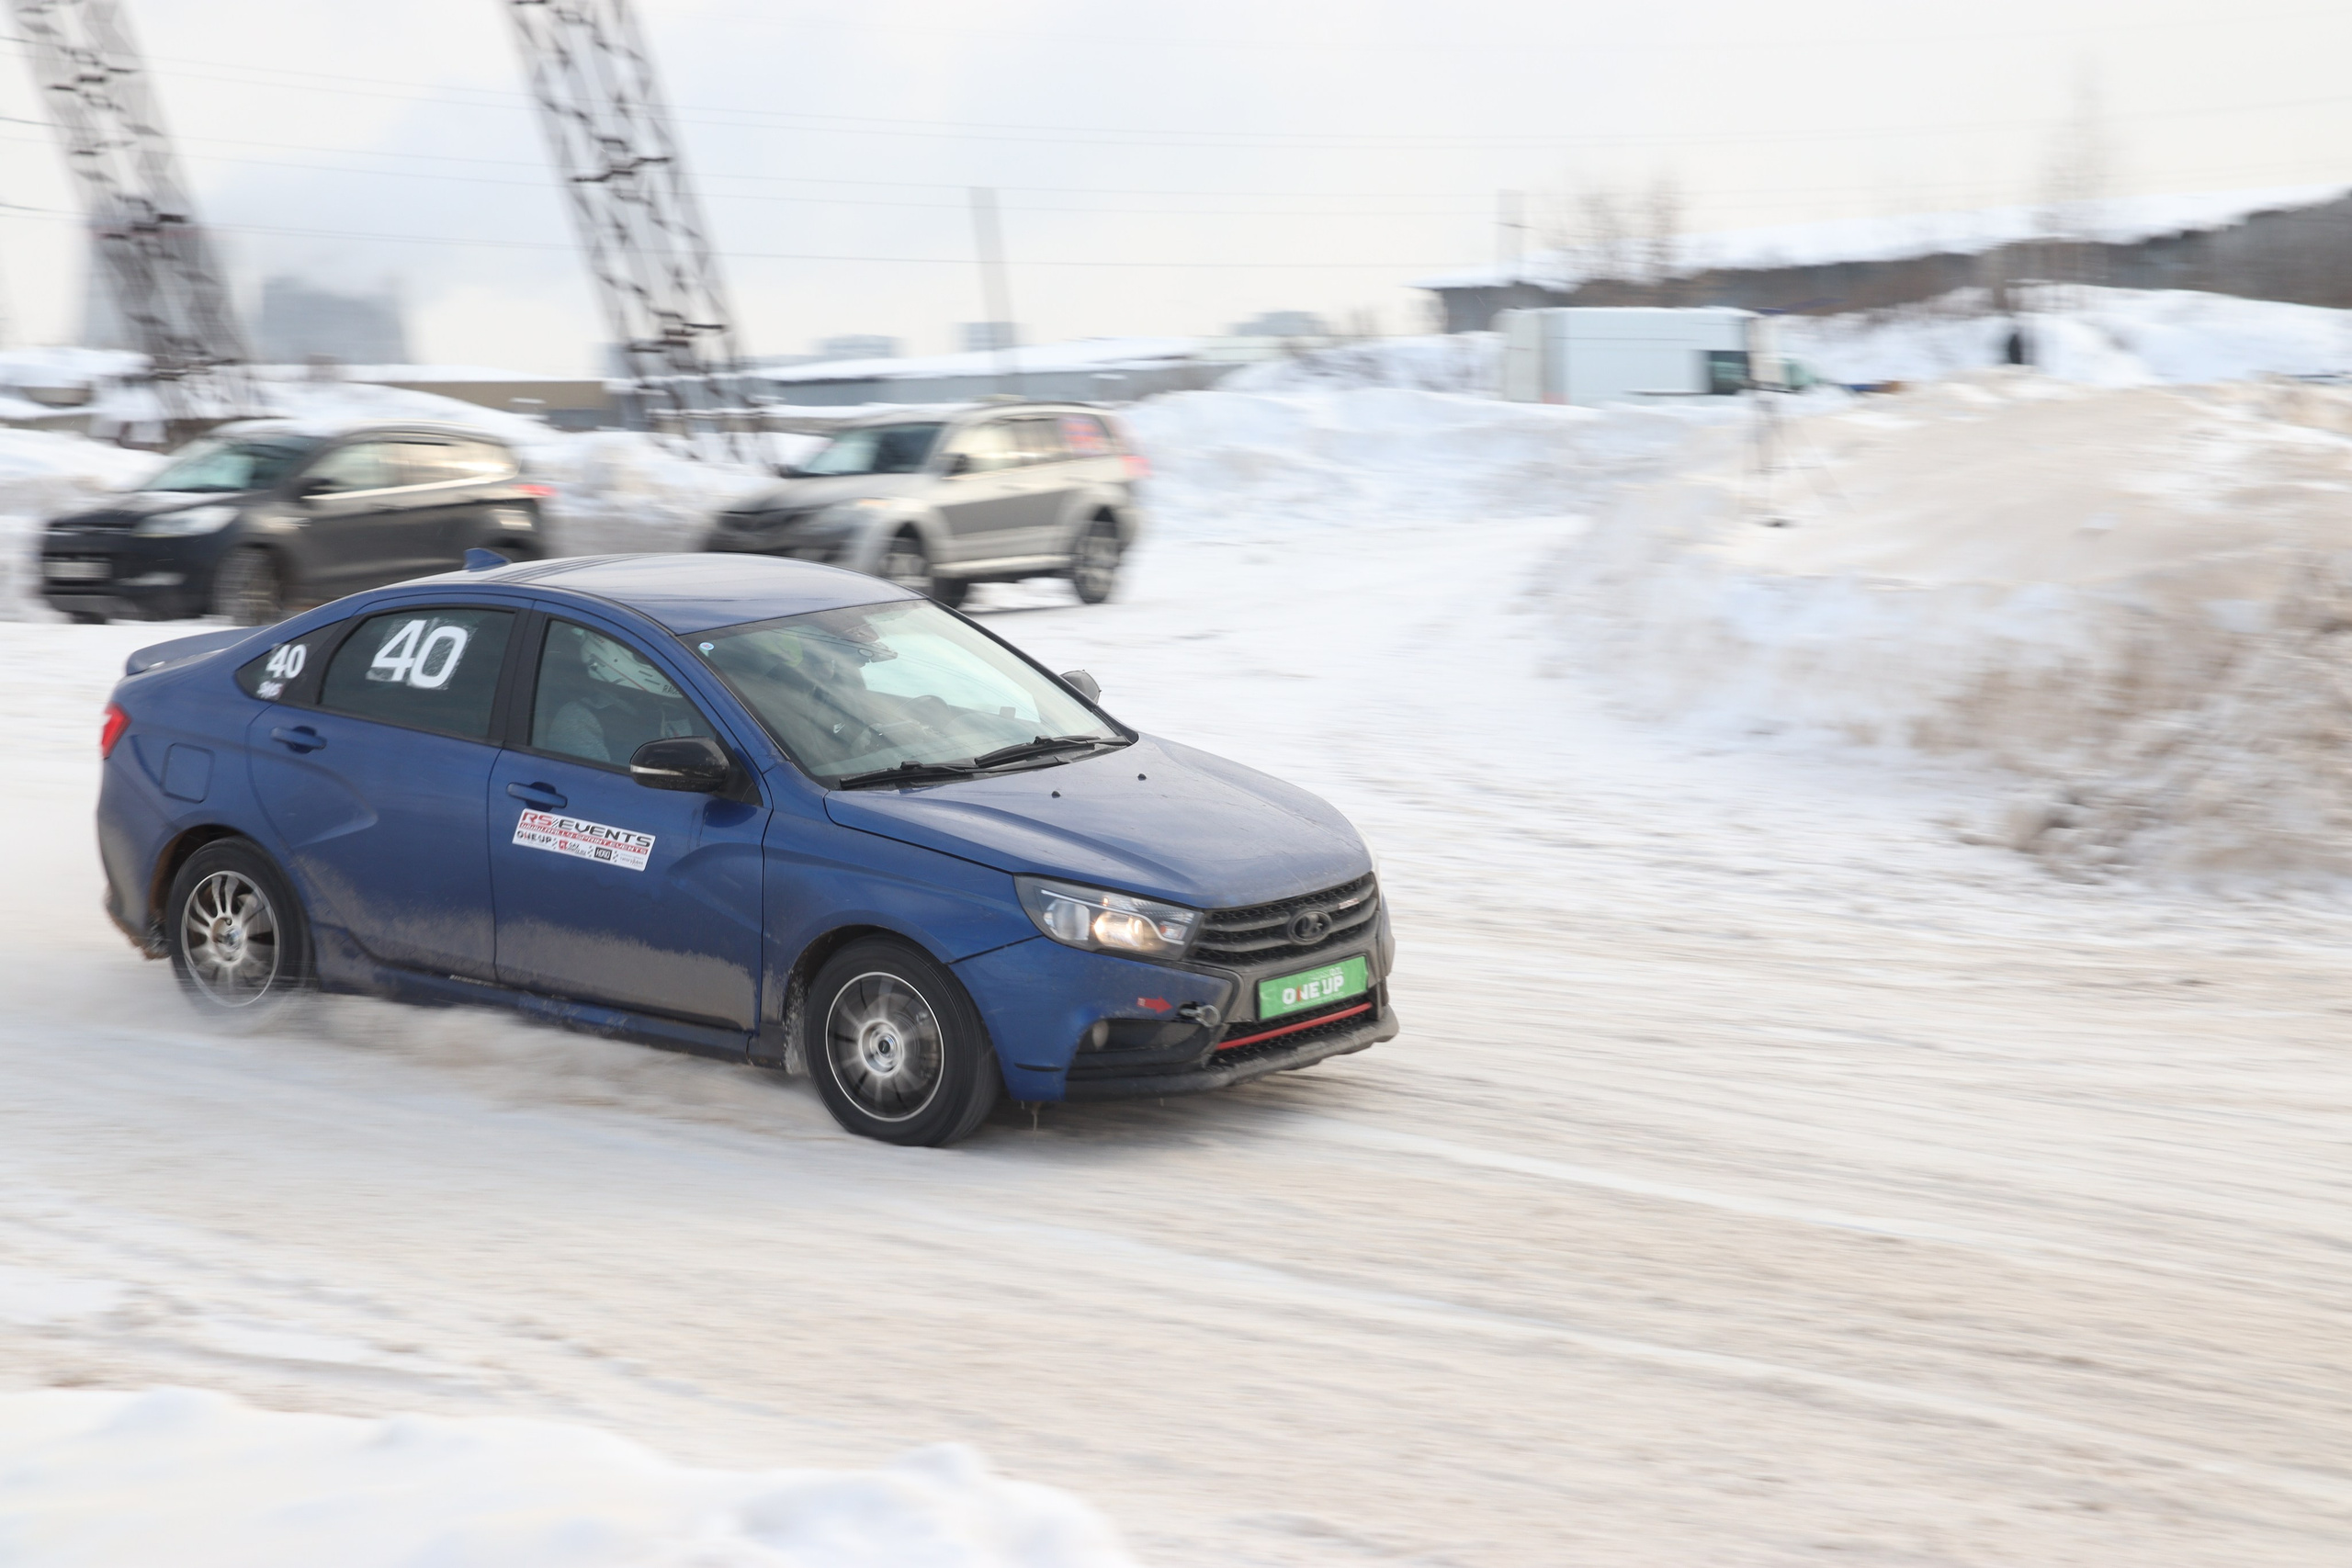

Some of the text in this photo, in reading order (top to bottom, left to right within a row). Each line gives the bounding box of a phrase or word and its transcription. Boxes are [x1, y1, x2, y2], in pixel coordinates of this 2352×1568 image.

[266, 644, 307, 679] 40
[371, 619, 468, 688] 40
[1282, 981, 1320, 1005] ONE
[1322, 975, 1345, 995] UP
